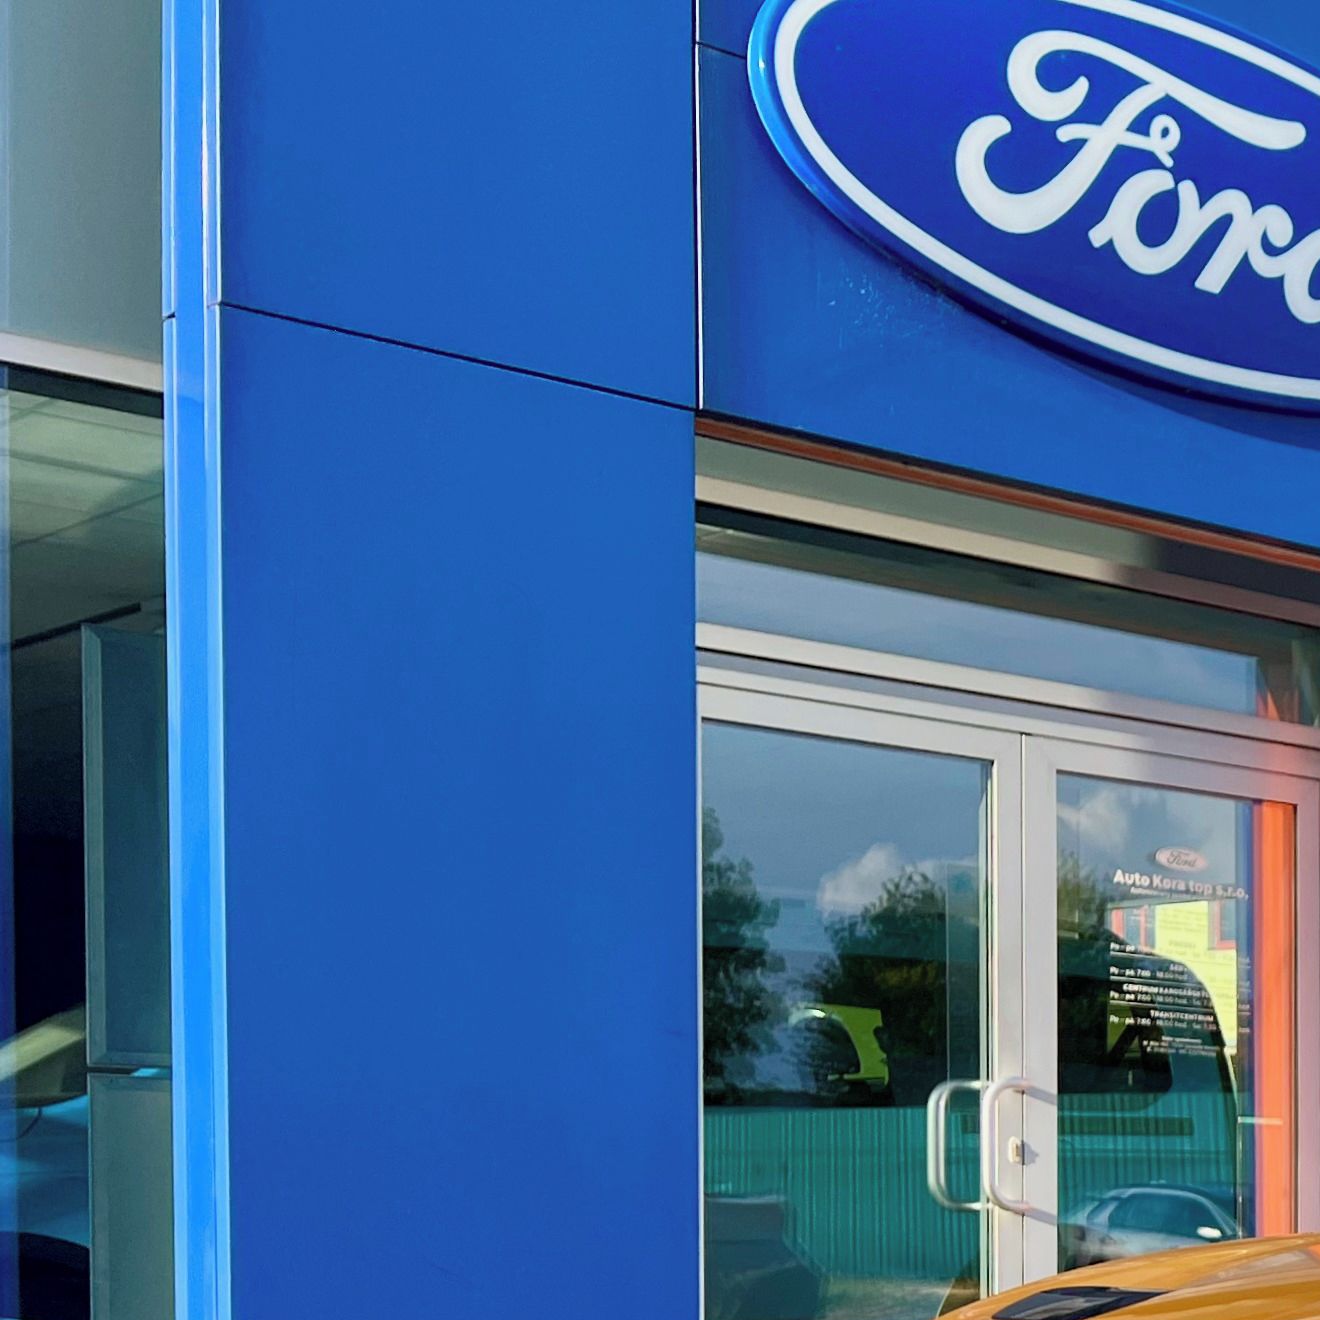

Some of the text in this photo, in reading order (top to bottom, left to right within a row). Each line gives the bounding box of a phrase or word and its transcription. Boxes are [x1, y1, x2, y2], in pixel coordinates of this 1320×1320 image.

[1167, 850, 1198, 868] Ford
[1113, 868, 1151, 887] Auto
[1152, 874, 1186, 890] Kora
[1188, 880, 1213, 896] top
